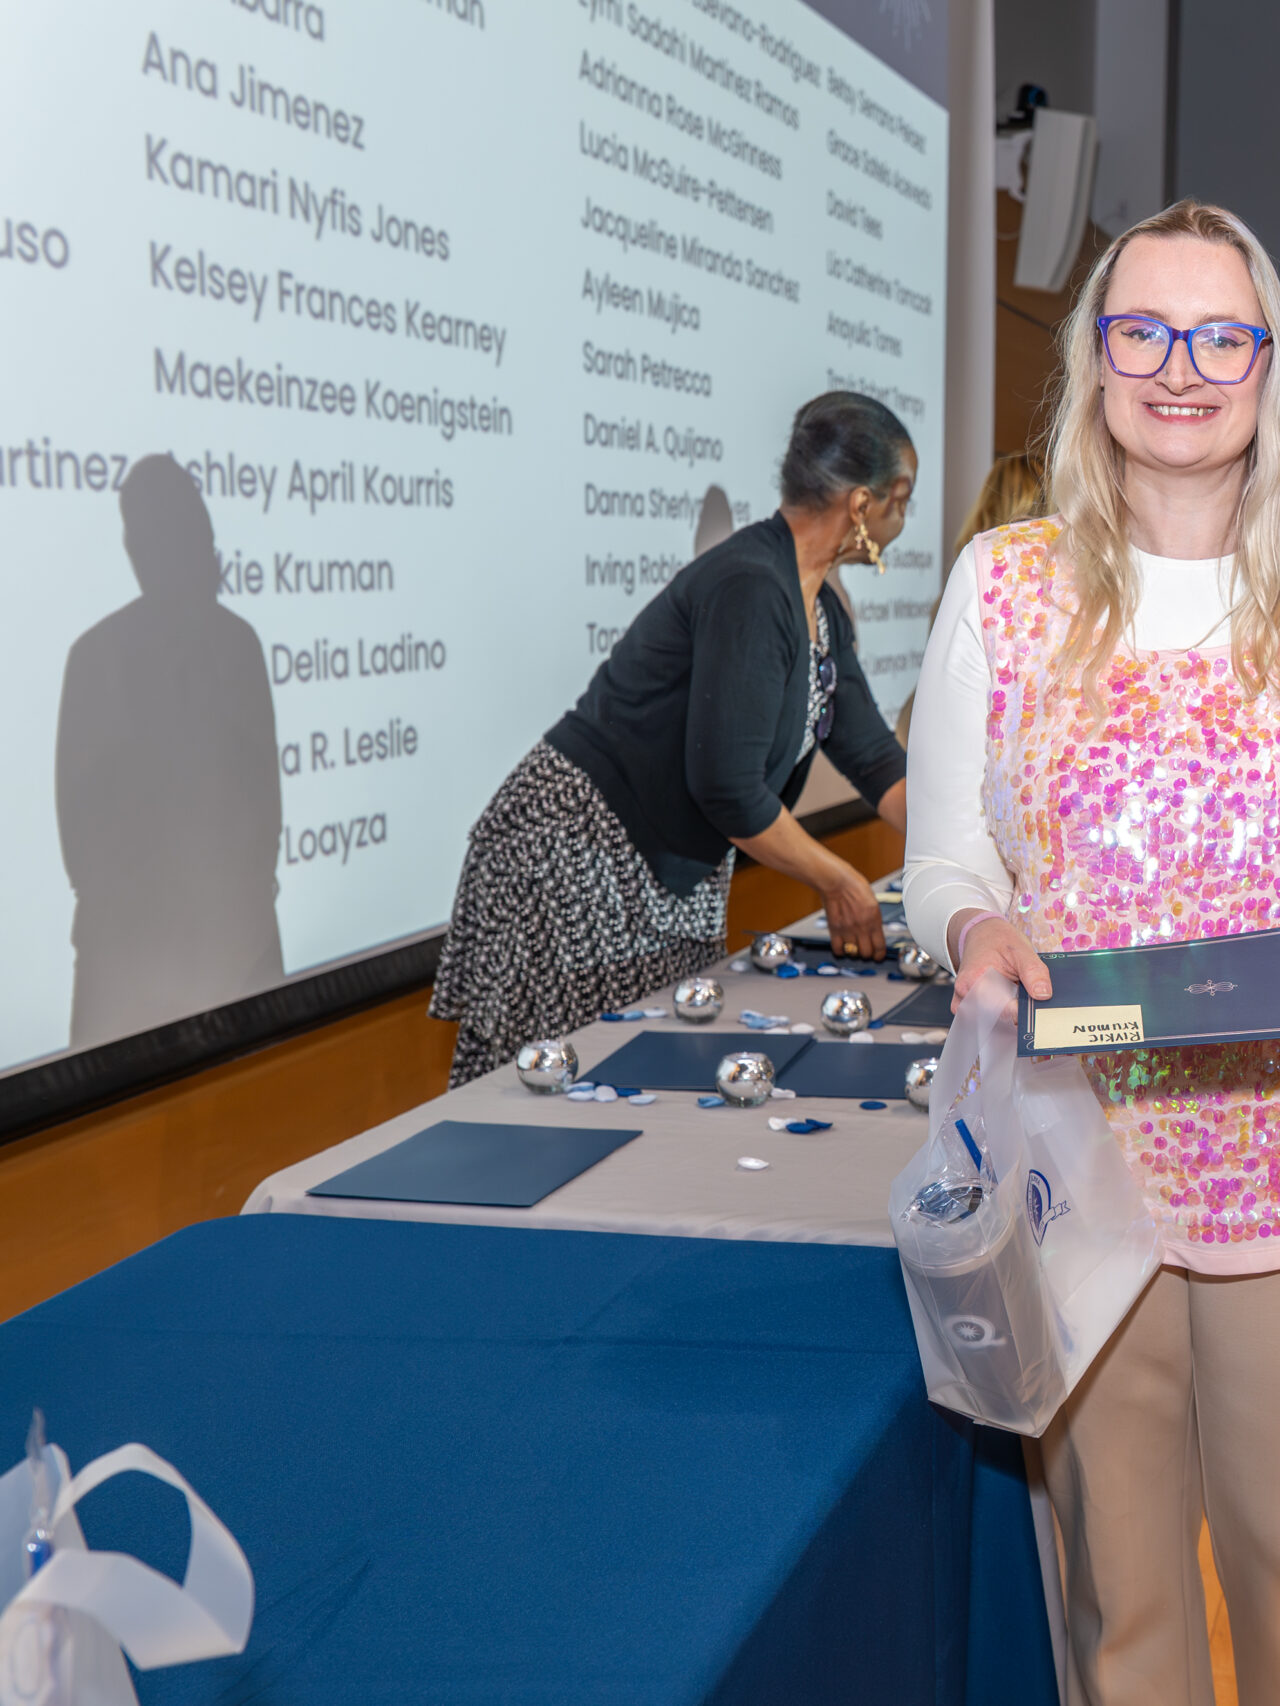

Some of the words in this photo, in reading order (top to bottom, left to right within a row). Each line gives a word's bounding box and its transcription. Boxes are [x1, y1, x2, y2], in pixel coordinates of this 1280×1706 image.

[142, 32, 218, 98] Ana
[230, 64, 365, 150] Jimenez
[666, 93, 704, 141] Rose
[579, 119, 629, 172] Lucia
[145, 134, 279, 214] Kamari
[289, 178, 362, 240] Nyfis
[371, 204, 450, 261] Jones
[580, 197, 679, 260] Jacqueline
[150, 242, 267, 323] Kelsey
[278, 270, 398, 335] Frances
[405, 300, 507, 367] Kearney
[582, 268, 644, 314] Ayleen
[647, 286, 701, 334] Mujica
[155, 348, 357, 417] Maekeinzee
[364, 380, 512, 441] Koenigstein
[583, 341, 637, 382] Sarah
[641, 353, 712, 398] Petrecca
[584, 413, 641, 452] Daniel
[664, 426, 724, 468] Quijano
[166, 450, 277, 514] shley
[288, 459, 355, 515] April
[363, 464, 454, 508] Kourris
[585, 483, 645, 518] Danna
[274, 551, 394, 594] Kruman
[585, 552, 634, 596] Irving
[272, 643, 349, 685] Delia
[358, 632, 446, 677] Ladino
[310, 732, 336, 772] R.
[343, 718, 418, 767] Leslie
[285, 812, 388, 866] Loayza
